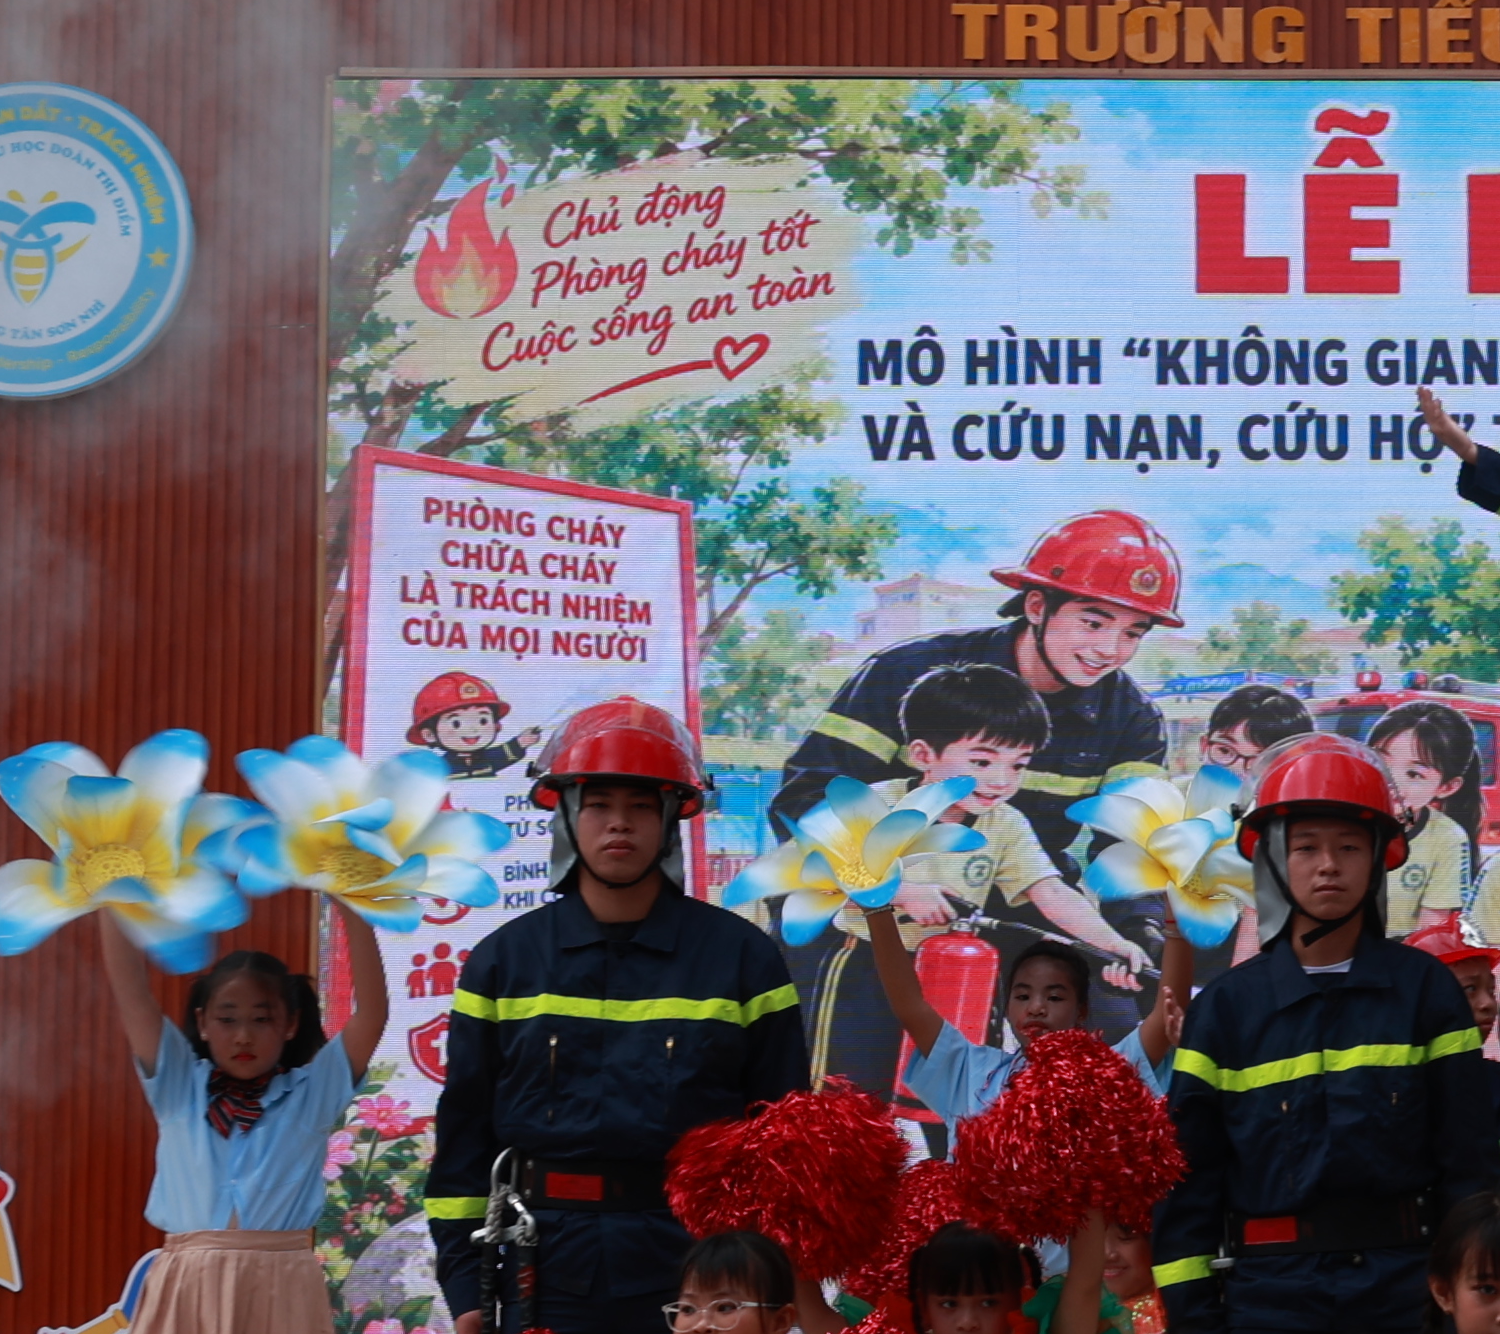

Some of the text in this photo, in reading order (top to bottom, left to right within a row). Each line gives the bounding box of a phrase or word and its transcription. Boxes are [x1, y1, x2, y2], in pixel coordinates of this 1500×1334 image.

[10, 141, 46, 154] HỌC
[49, 142, 97, 171] ĐOÀN
[95, 168, 119, 196] THỊ
[542, 182, 726, 248] Chủ động
[1193, 107, 1402, 295] LỄ
[529, 208, 822, 309] Phòng cháy tốt
[856, 324, 946, 387] MÔ
[964, 324, 1103, 386] HÌNH
[1122, 324, 1349, 387] “KHÔNG
[1365, 337, 1499, 387] GIAN
[863, 401, 935, 462] VÀ
[952, 400, 1066, 463] CỨU
[1085, 413, 1221, 473] NẠN,
[1237, 400, 1349, 463] CỨU
[422, 497, 626, 549] PHÒNG CHÁY
[440, 538, 618, 585] CHỮA CHÁY
[399, 570, 652, 629] LÀ TRÁCH NHIỆM
[401, 610, 648, 663] CỦA MỌI NGƯỜI
[504, 890, 535, 911] KHI
